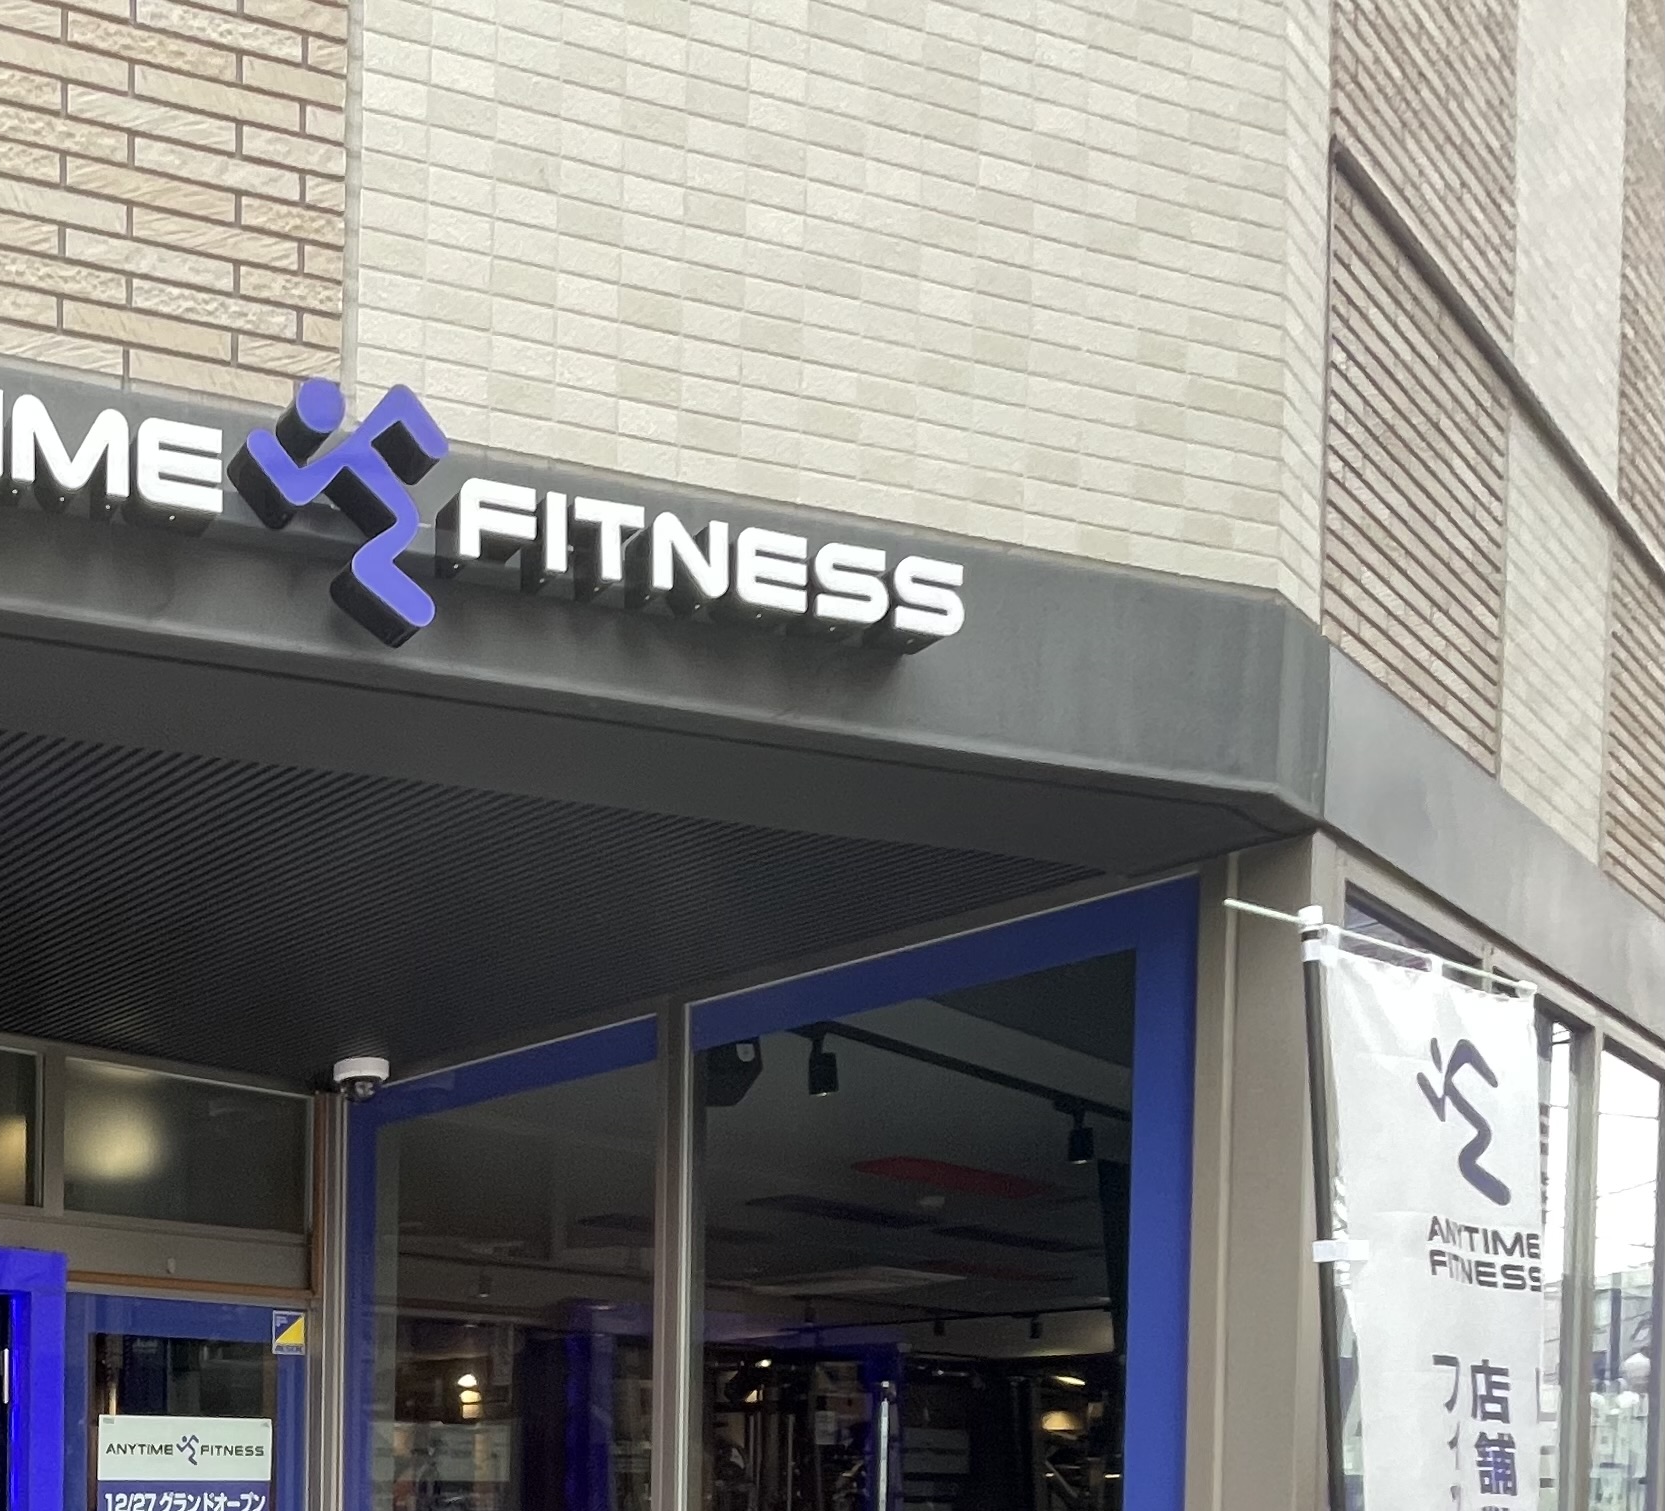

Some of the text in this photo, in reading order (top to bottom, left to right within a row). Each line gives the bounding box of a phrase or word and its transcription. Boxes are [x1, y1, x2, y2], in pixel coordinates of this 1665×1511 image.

[457, 477, 965, 637] FITNESS
[105, 1443, 265, 1457] ANYTIME FITNESS
